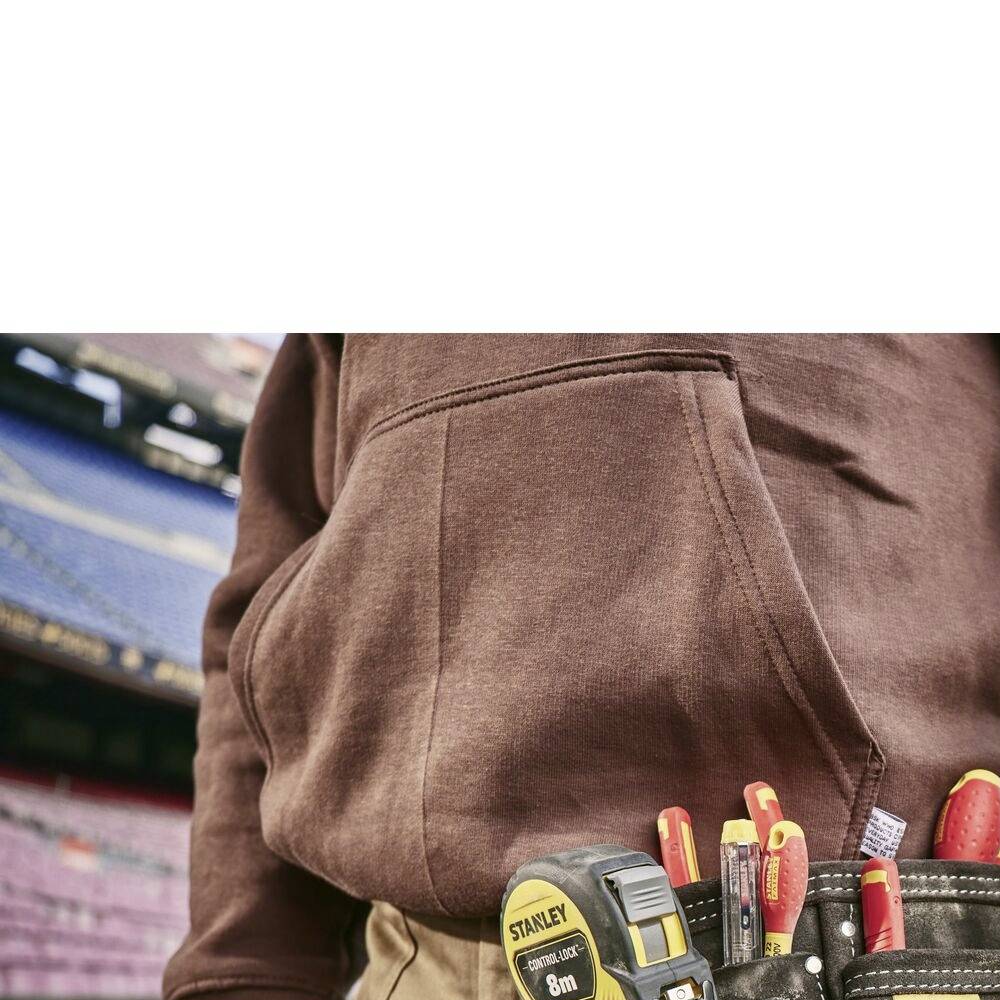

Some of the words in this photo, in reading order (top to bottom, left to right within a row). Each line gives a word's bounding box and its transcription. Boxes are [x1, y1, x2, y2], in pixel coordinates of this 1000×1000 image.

[862, 841, 878, 852] EASON
[509, 903, 568, 941] STANLEY
[545, 973, 578, 997] 8m
